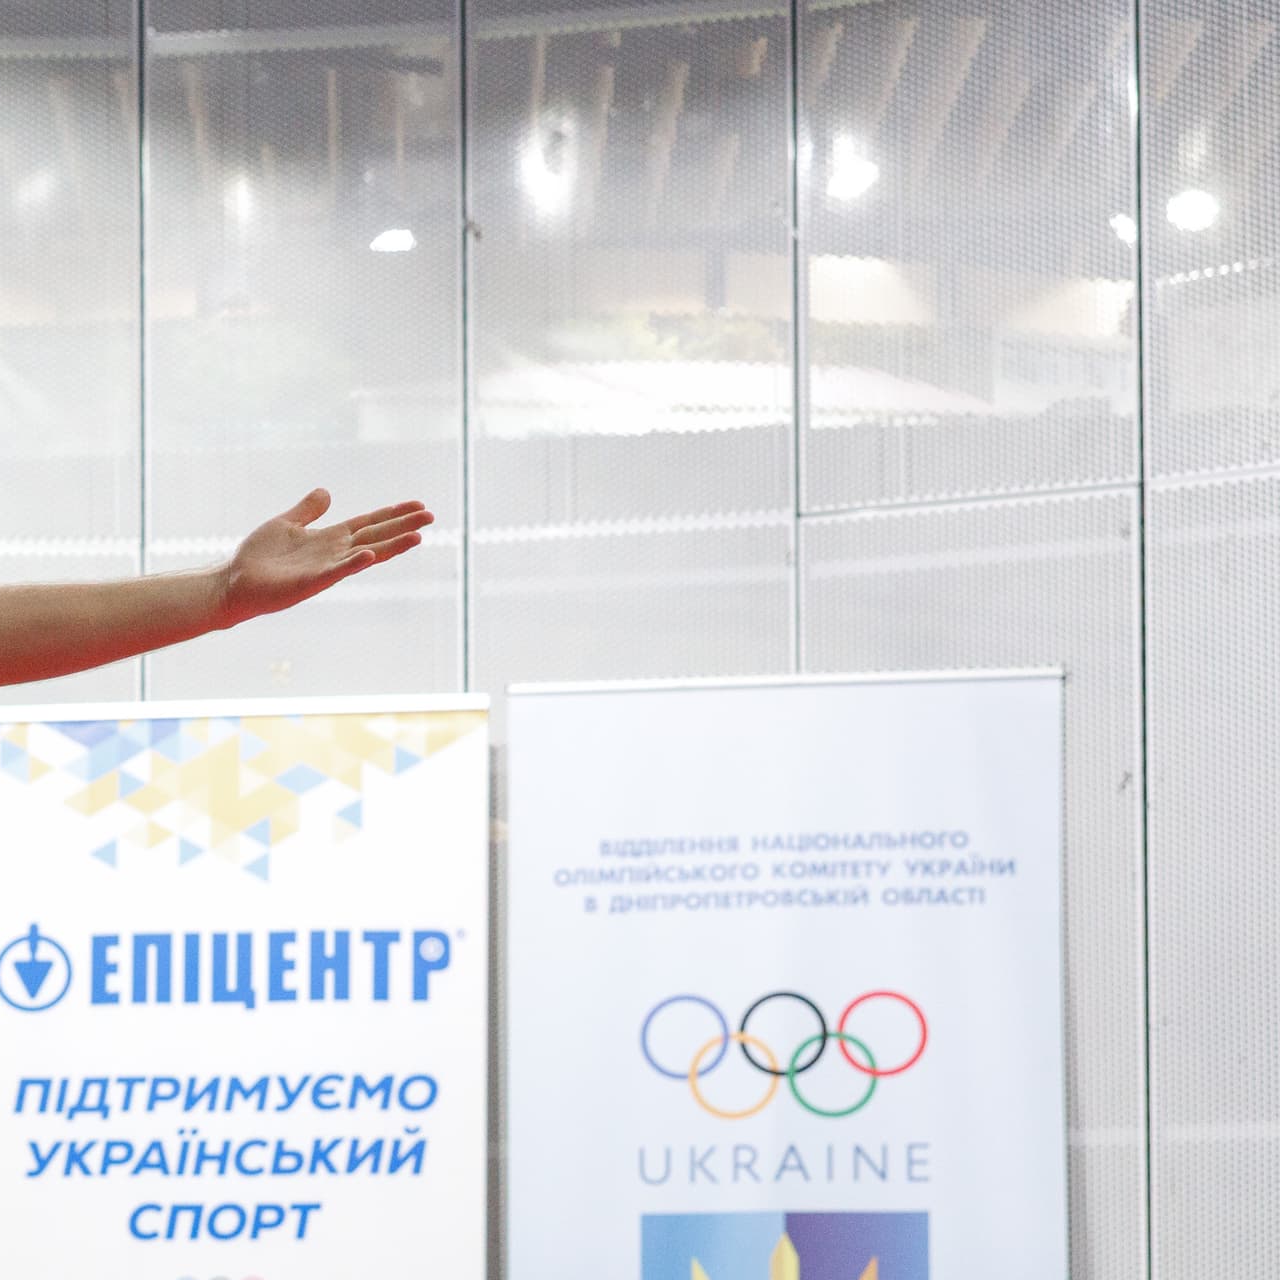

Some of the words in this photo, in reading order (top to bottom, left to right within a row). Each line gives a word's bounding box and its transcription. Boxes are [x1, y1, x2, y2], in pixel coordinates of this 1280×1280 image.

[599, 836, 739, 858] ВІДДІЛЕННЯ
[752, 830, 970, 853] НАЦІОНАЛЬНОГО
[553, 863, 760, 887] ОЛІМПІЙСЬКОГО
[772, 860, 890, 879] КОМІТЕТУ
[904, 854, 1017, 877] УКРАЇНИ
[583, 896, 598, 914] В
[882, 886, 986, 906] ОБЛАСТІ
[90, 930, 452, 1010] ЕПІЦЕНТР
[14, 1073, 439, 1120] ПІДТРИМУЄМО
[25, 1126, 427, 1178] УКРАЇНСЬКИЙ
[639, 1142, 930, 1186] UKRAINE
[127, 1203, 322, 1242] СПОРТ
